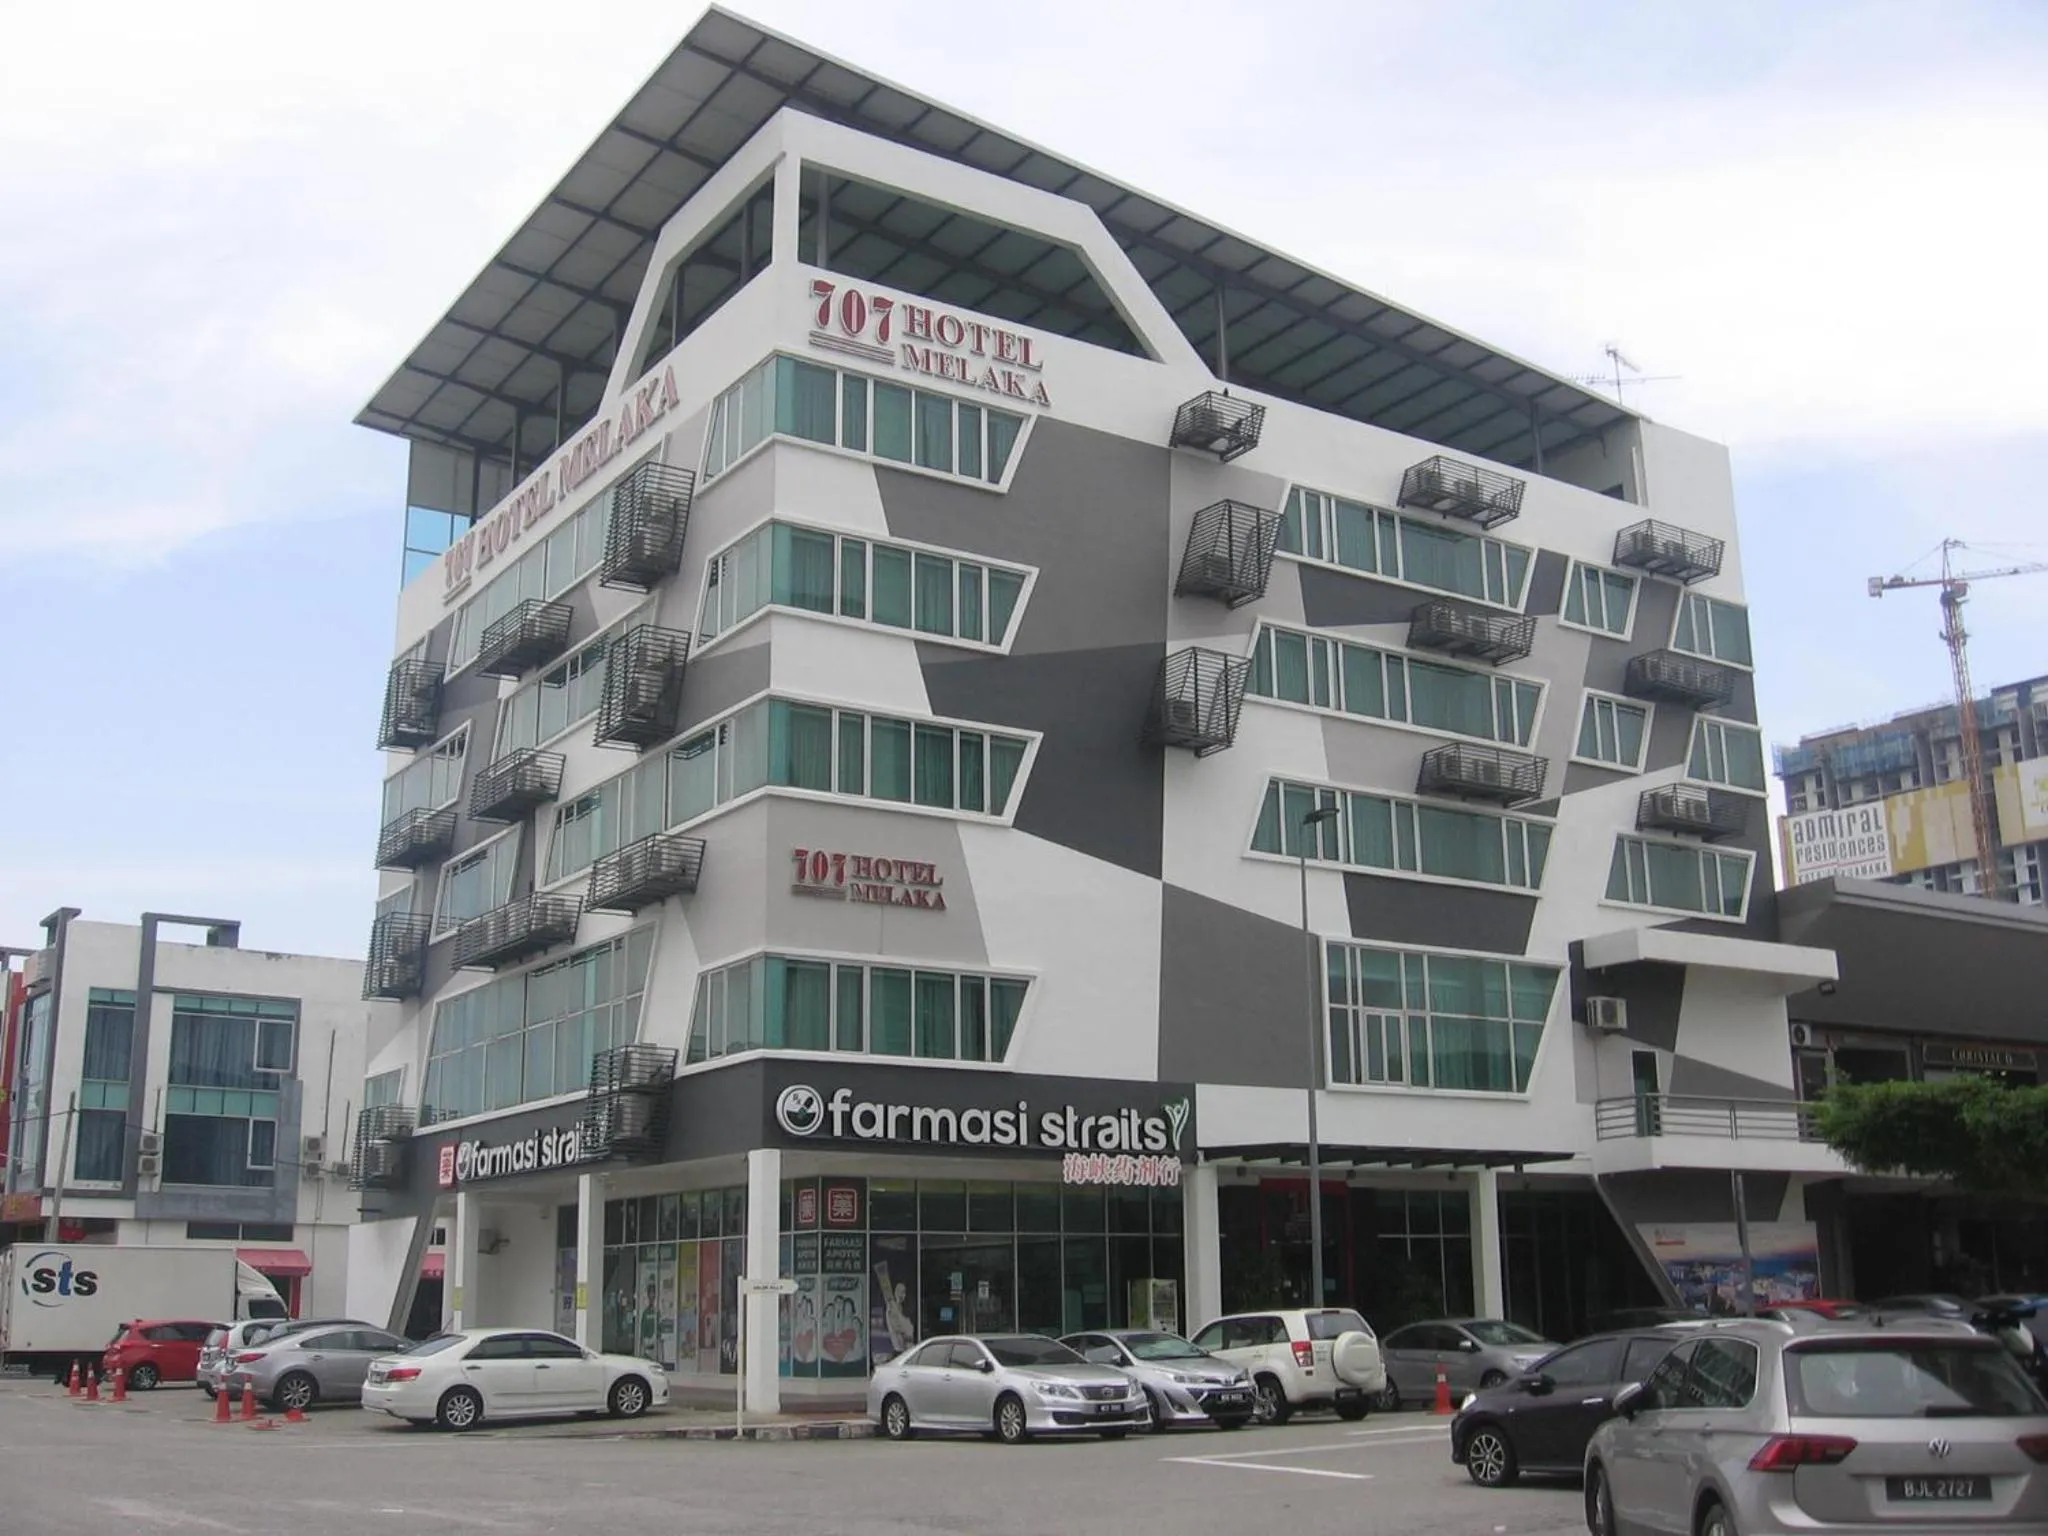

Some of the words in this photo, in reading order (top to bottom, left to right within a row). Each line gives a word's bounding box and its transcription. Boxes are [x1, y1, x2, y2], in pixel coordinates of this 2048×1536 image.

[809, 279, 894, 345] 707
[901, 303, 1044, 372] HOTEL
[901, 343, 1052, 406] MELAKA
[477, 471, 556, 570] HOTEL
[558, 364, 681, 502] MELAKA
[792, 848, 847, 887] 707
[851, 855, 944, 887] HOTEL
[850, 882, 947, 911] MELAKA
[827, 1087, 1029, 1147] farmasi
[1039, 1104, 1169, 1152] straits
[471, 1129, 539, 1178] farmasi
[31, 1260, 98, 1297] sts
[1904, 1479, 1933, 1498] BJL
[1937, 1480, 1974, 1498] 2727
